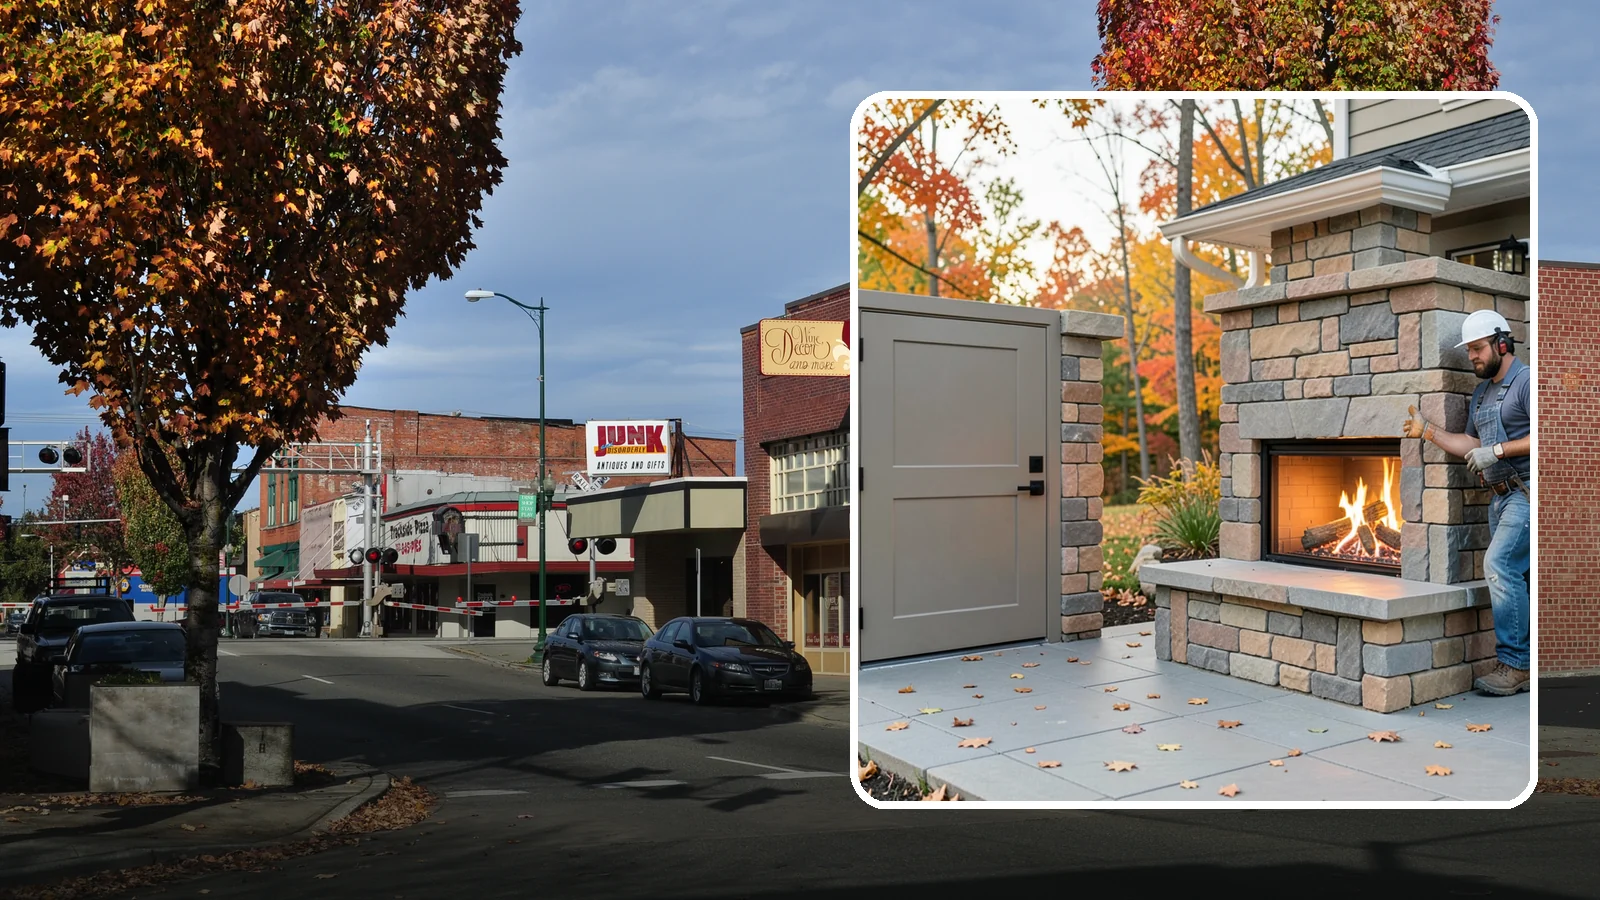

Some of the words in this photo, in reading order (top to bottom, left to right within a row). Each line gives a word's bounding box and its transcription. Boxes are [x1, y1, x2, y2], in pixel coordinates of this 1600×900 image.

[595, 425, 665, 457] JUNK
[607, 446, 646, 454] DISORDERLY
[596, 461, 628, 470] ANTIQUES
[631, 461, 644, 470] AND
[647, 460, 666, 470] GIFTS
[573, 473, 587, 491] RAIL
[390, 522, 413, 540] Trackside
[414, 519, 429, 535] Pizza
